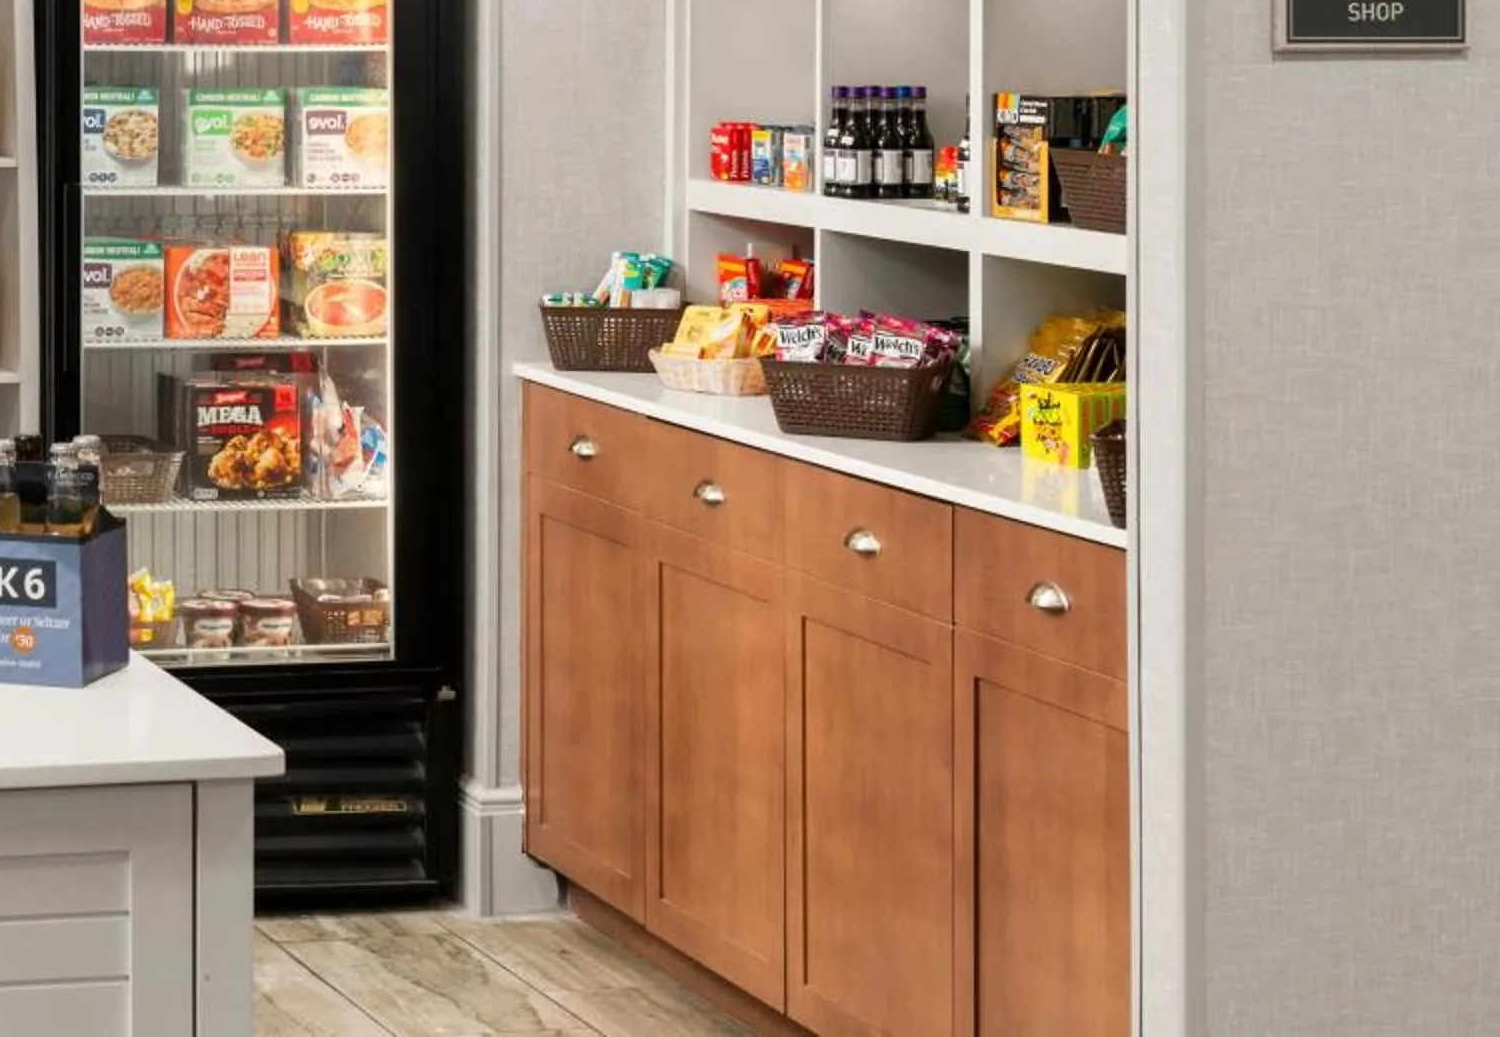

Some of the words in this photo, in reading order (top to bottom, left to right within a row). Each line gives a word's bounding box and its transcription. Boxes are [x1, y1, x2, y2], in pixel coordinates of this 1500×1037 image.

[1348, 3, 1404, 22] SHOP
[197, 404, 265, 427] MEGA
[23, 568, 46, 600] 6
